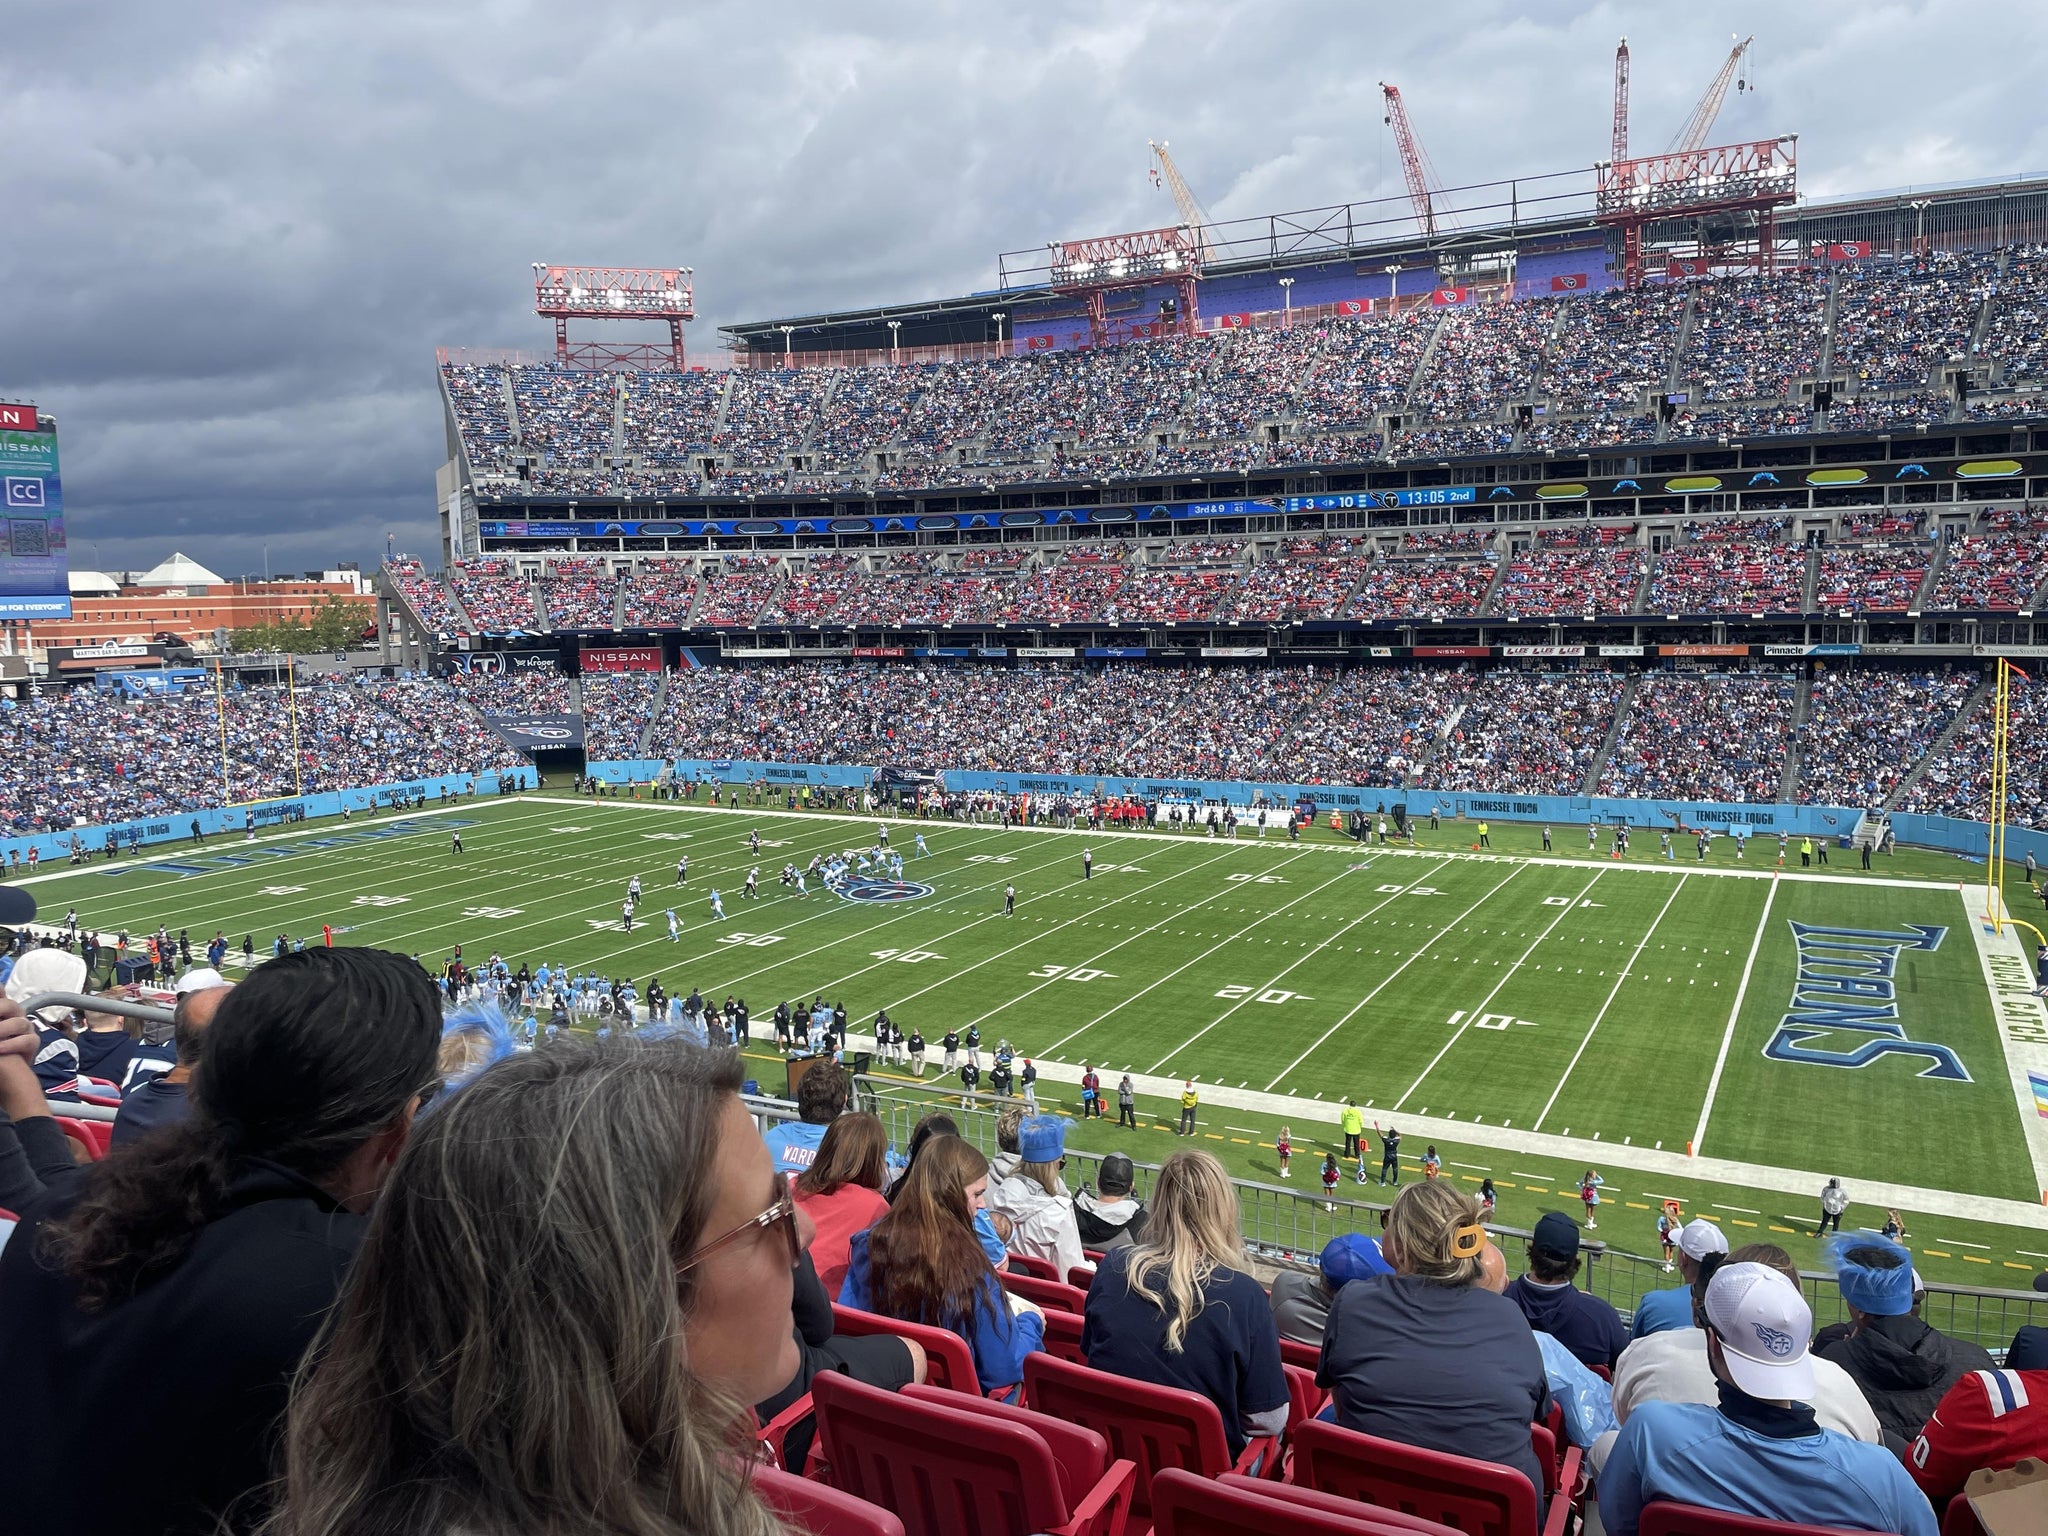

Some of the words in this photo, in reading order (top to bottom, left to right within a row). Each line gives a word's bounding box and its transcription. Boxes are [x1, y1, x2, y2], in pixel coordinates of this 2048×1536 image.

[12, 485, 37, 499] CC
[1407, 491, 1445, 504] 13:05
[1450, 491, 1470, 500] 2nd
[1195, 503, 1209, 513] 3rd
[1218, 503, 1225, 512] 9
[1306, 498, 1314, 509] 3
[1339, 496, 1353, 508] 10
[590, 653, 651, 662] NISSAN
[1673, 647, 1698, 655] Tito's
[1766, 646, 1804, 655] Pinnacle
[527, 656, 555, 670] Kroger
[531, 743, 566, 751] NISSAN
[1338, 795, 1361, 805] TOUGH
[1471, 801, 1510, 812] TENNESSEE
[1513, 803, 1538, 813] TOUGH
[1696, 811, 1740, 823] TENNESSEE
[1744, 812, 1774, 825] TOUGH
[147, 823, 170, 837] TOUGH
[716, 932, 786, 947] 50
[869, 948, 938, 963] 40
[1028, 964, 1106, 982] 30
[1987, 953, 2033, 996] CRUCIAL
[1213, 984, 1298, 1005] 20
[1761, 918, 1976, 1084] TITANS
[1446, 1010, 1516, 1031] 10
